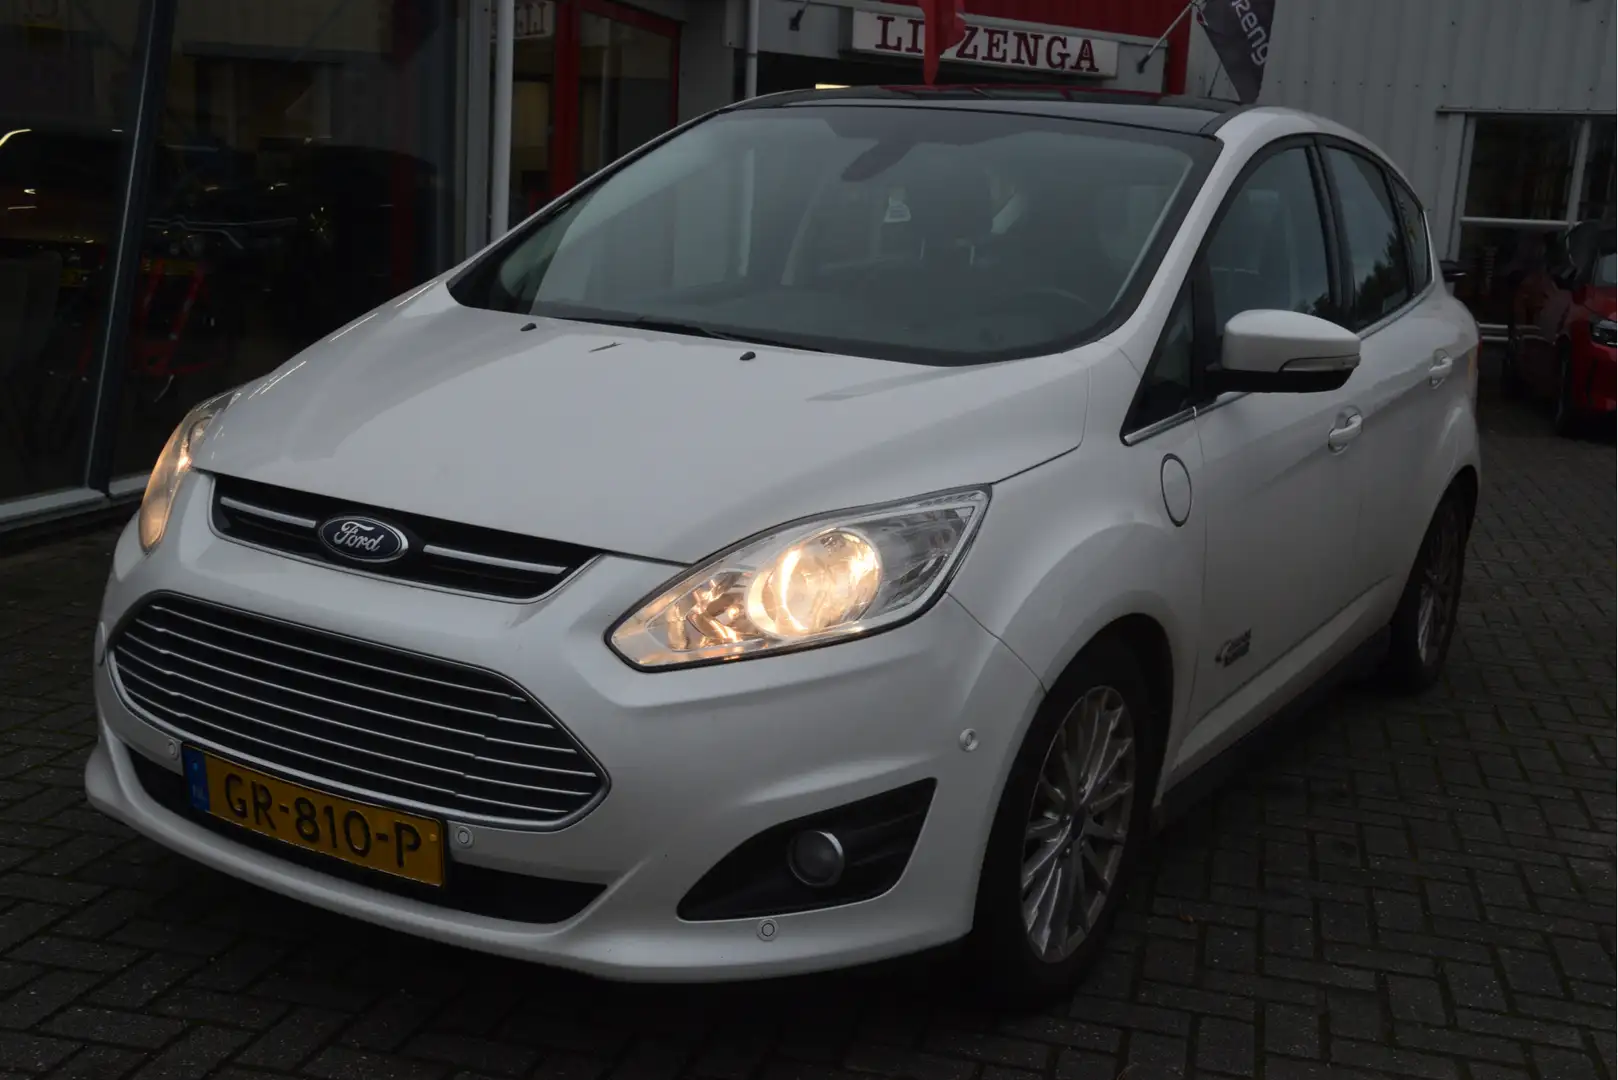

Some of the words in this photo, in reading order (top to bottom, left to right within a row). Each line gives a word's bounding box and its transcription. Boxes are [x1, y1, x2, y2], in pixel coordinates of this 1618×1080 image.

[875, 16, 1100, 73] LIZENGA
[333, 521, 384, 552] Ford
[225, 774, 422, 868] GR-810-P
